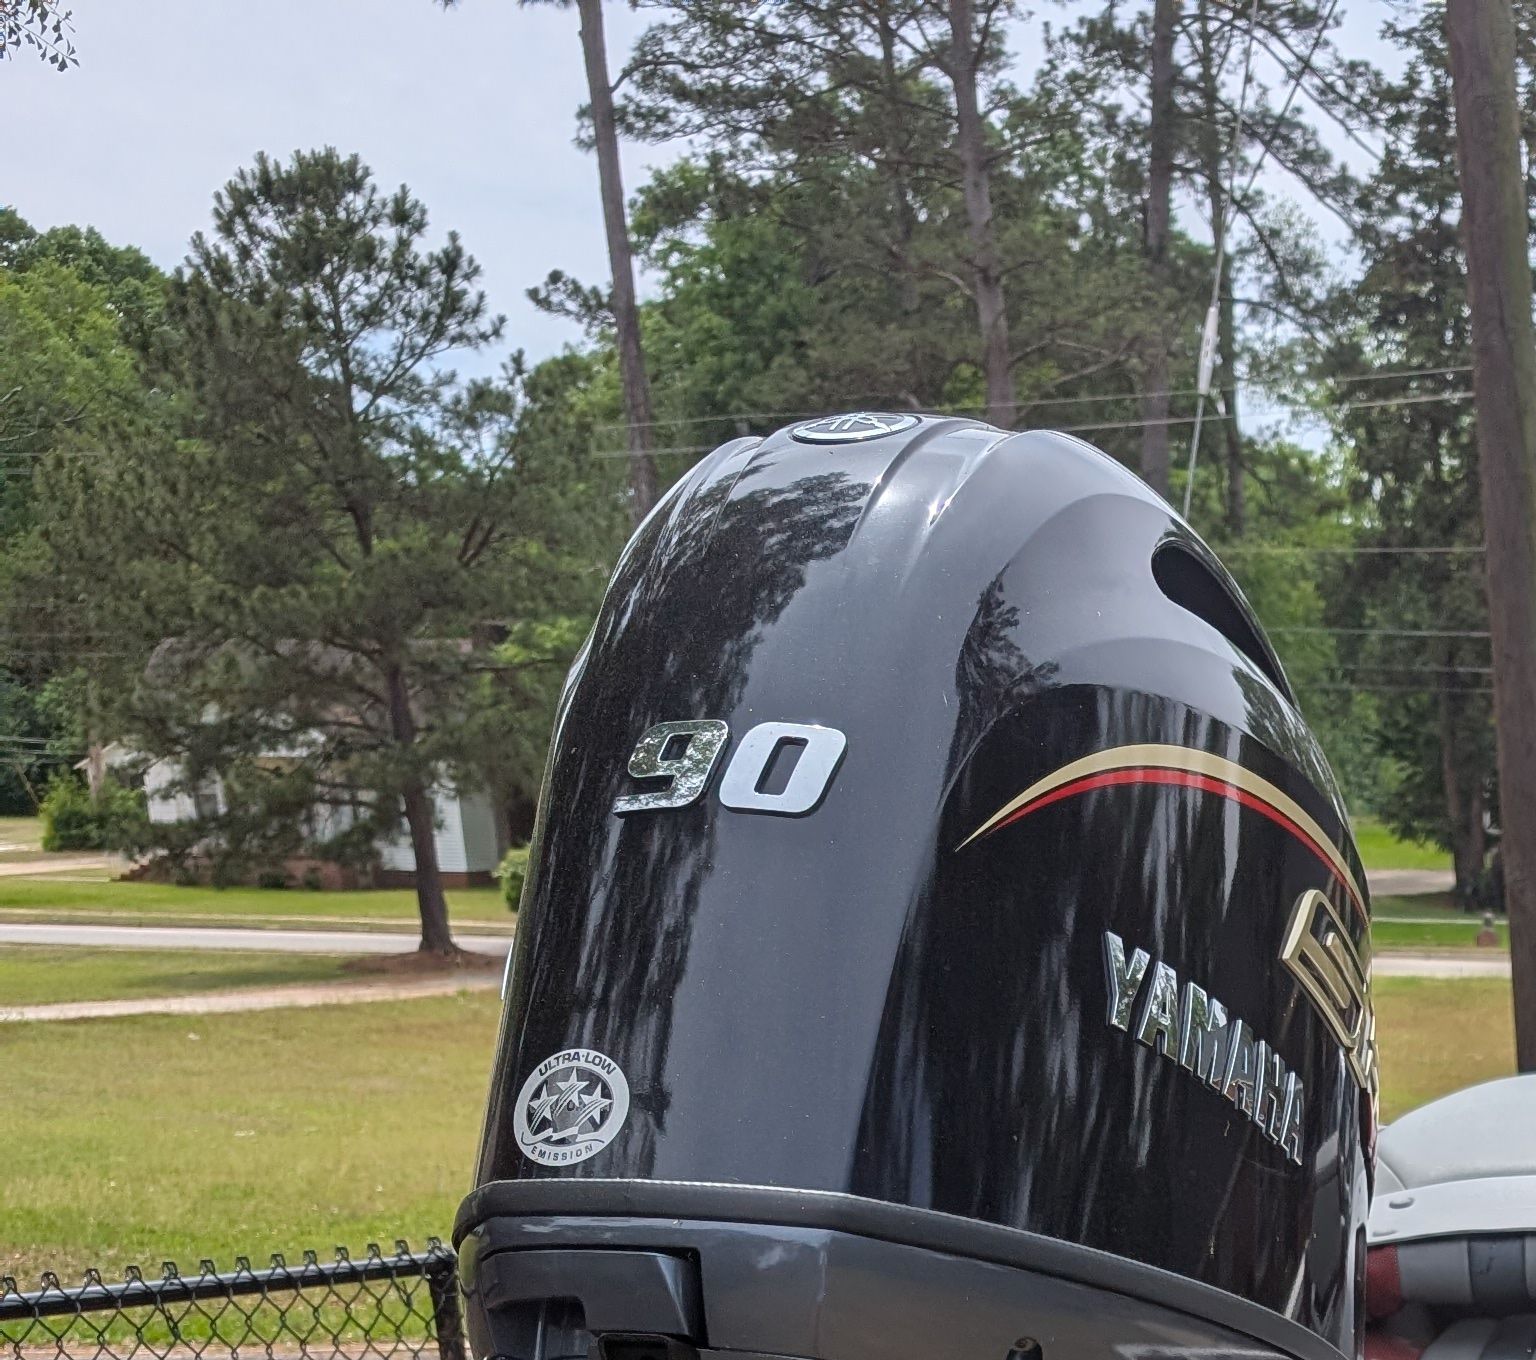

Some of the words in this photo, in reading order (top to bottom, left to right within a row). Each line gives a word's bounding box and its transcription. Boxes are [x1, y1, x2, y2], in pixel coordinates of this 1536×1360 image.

[613, 719, 847, 816] 90
[1103, 930, 1304, 1166] YAMAHA
[530, 1143, 594, 1161] EMISSION
